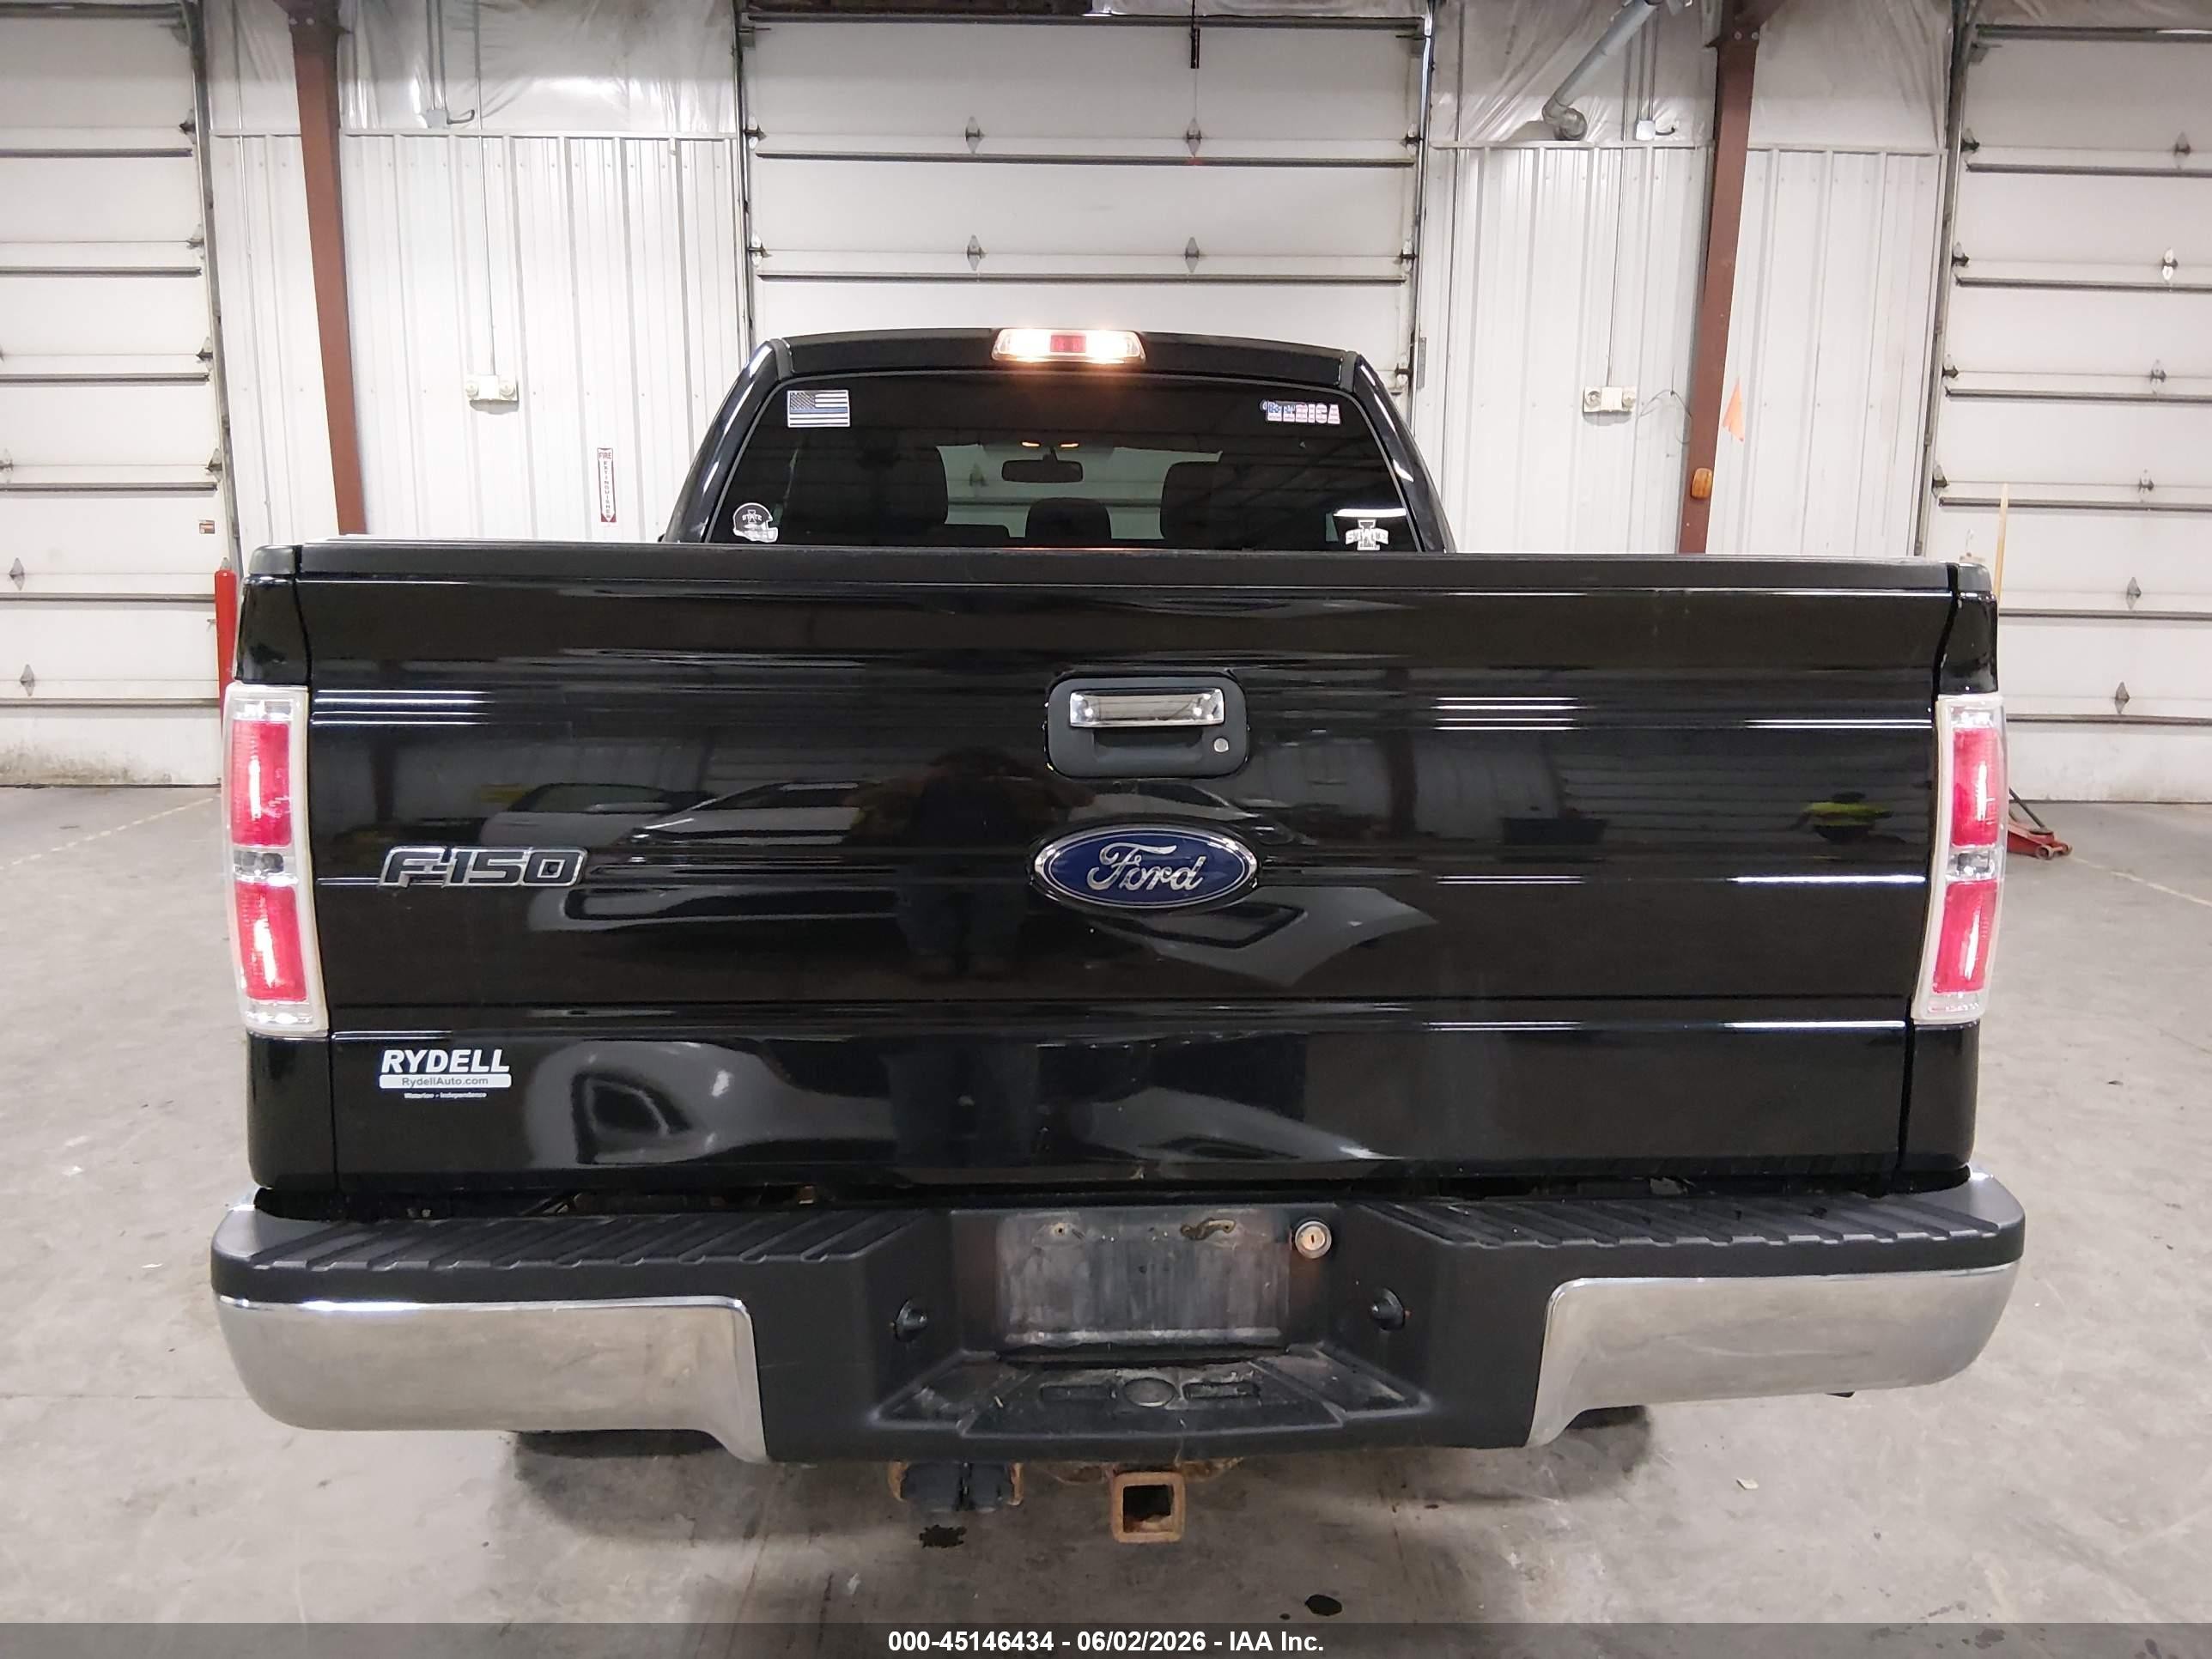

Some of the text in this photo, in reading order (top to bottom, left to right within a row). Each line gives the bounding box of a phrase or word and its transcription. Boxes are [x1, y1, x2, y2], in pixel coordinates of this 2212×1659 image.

[1086, 842, 1206, 890] Ford
[381, 1048, 510, 1073] RYDELL
[402, 1077, 489, 1088] RydellAuto.com
